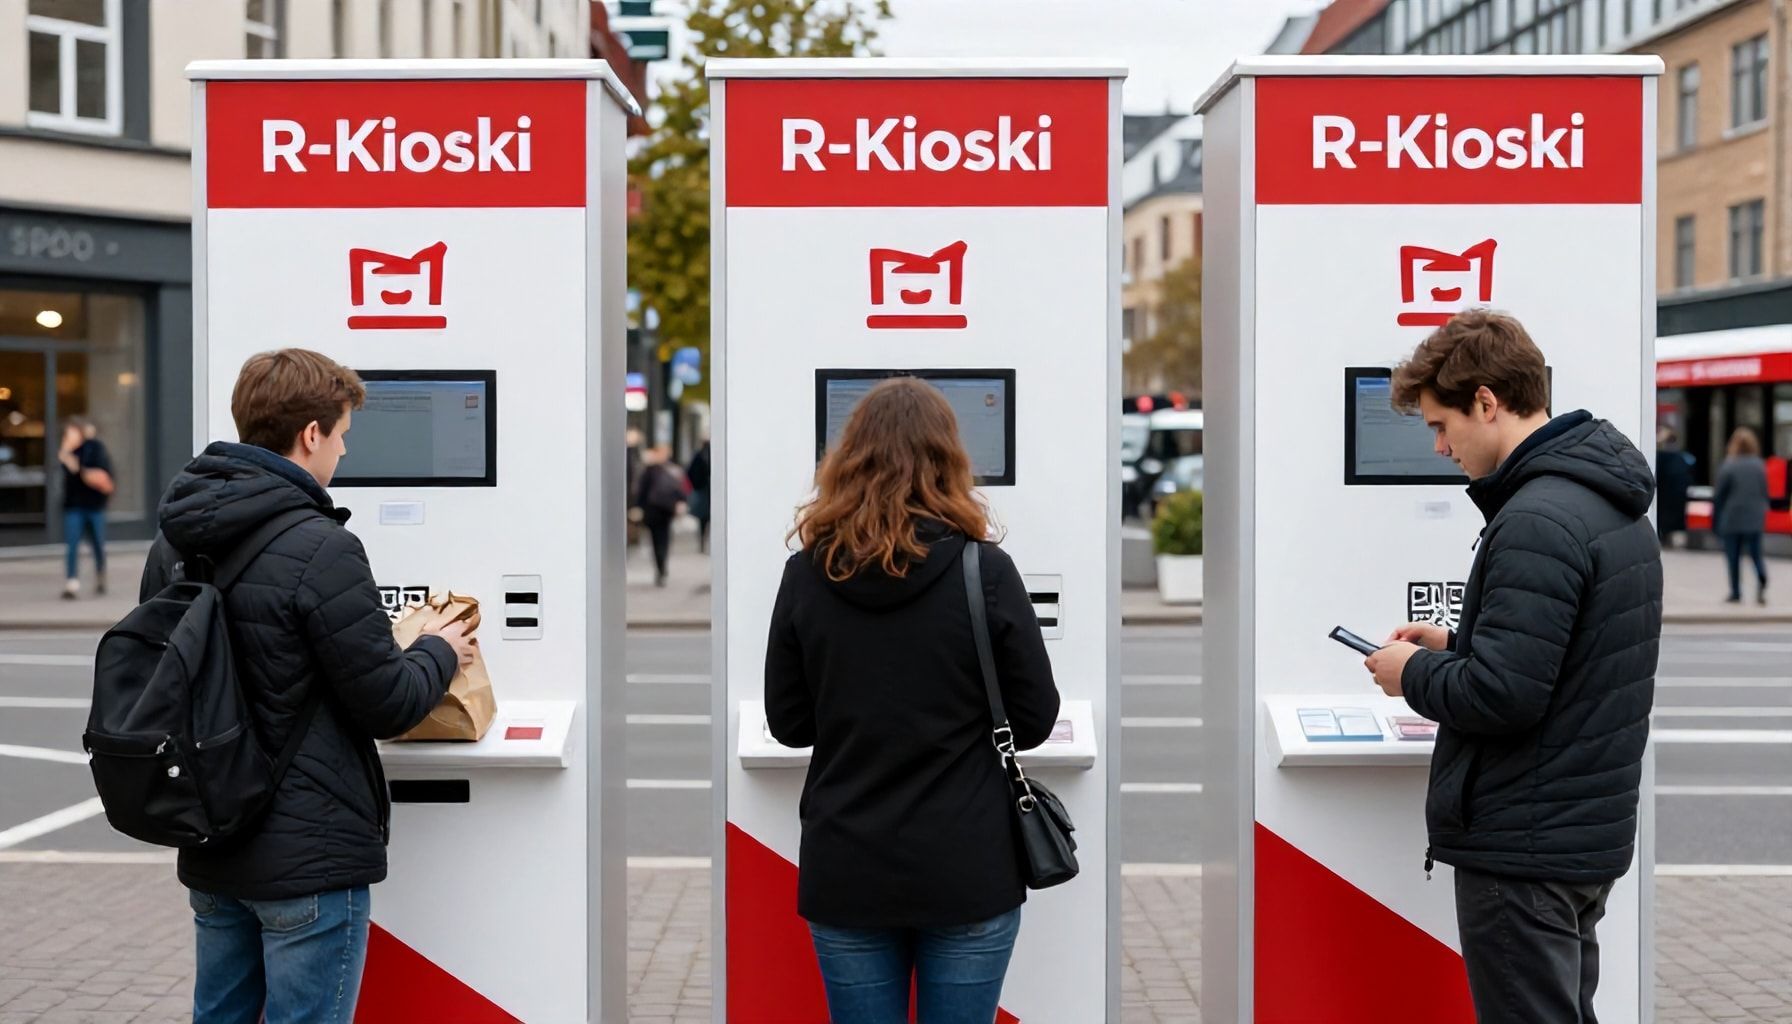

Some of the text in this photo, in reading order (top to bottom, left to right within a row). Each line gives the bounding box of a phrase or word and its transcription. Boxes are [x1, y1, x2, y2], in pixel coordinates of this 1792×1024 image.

[262, 115, 532, 173] R-Kioski
[782, 114, 1053, 172] R-Kioski
[1312, 112, 1585, 170] R-Kioski
